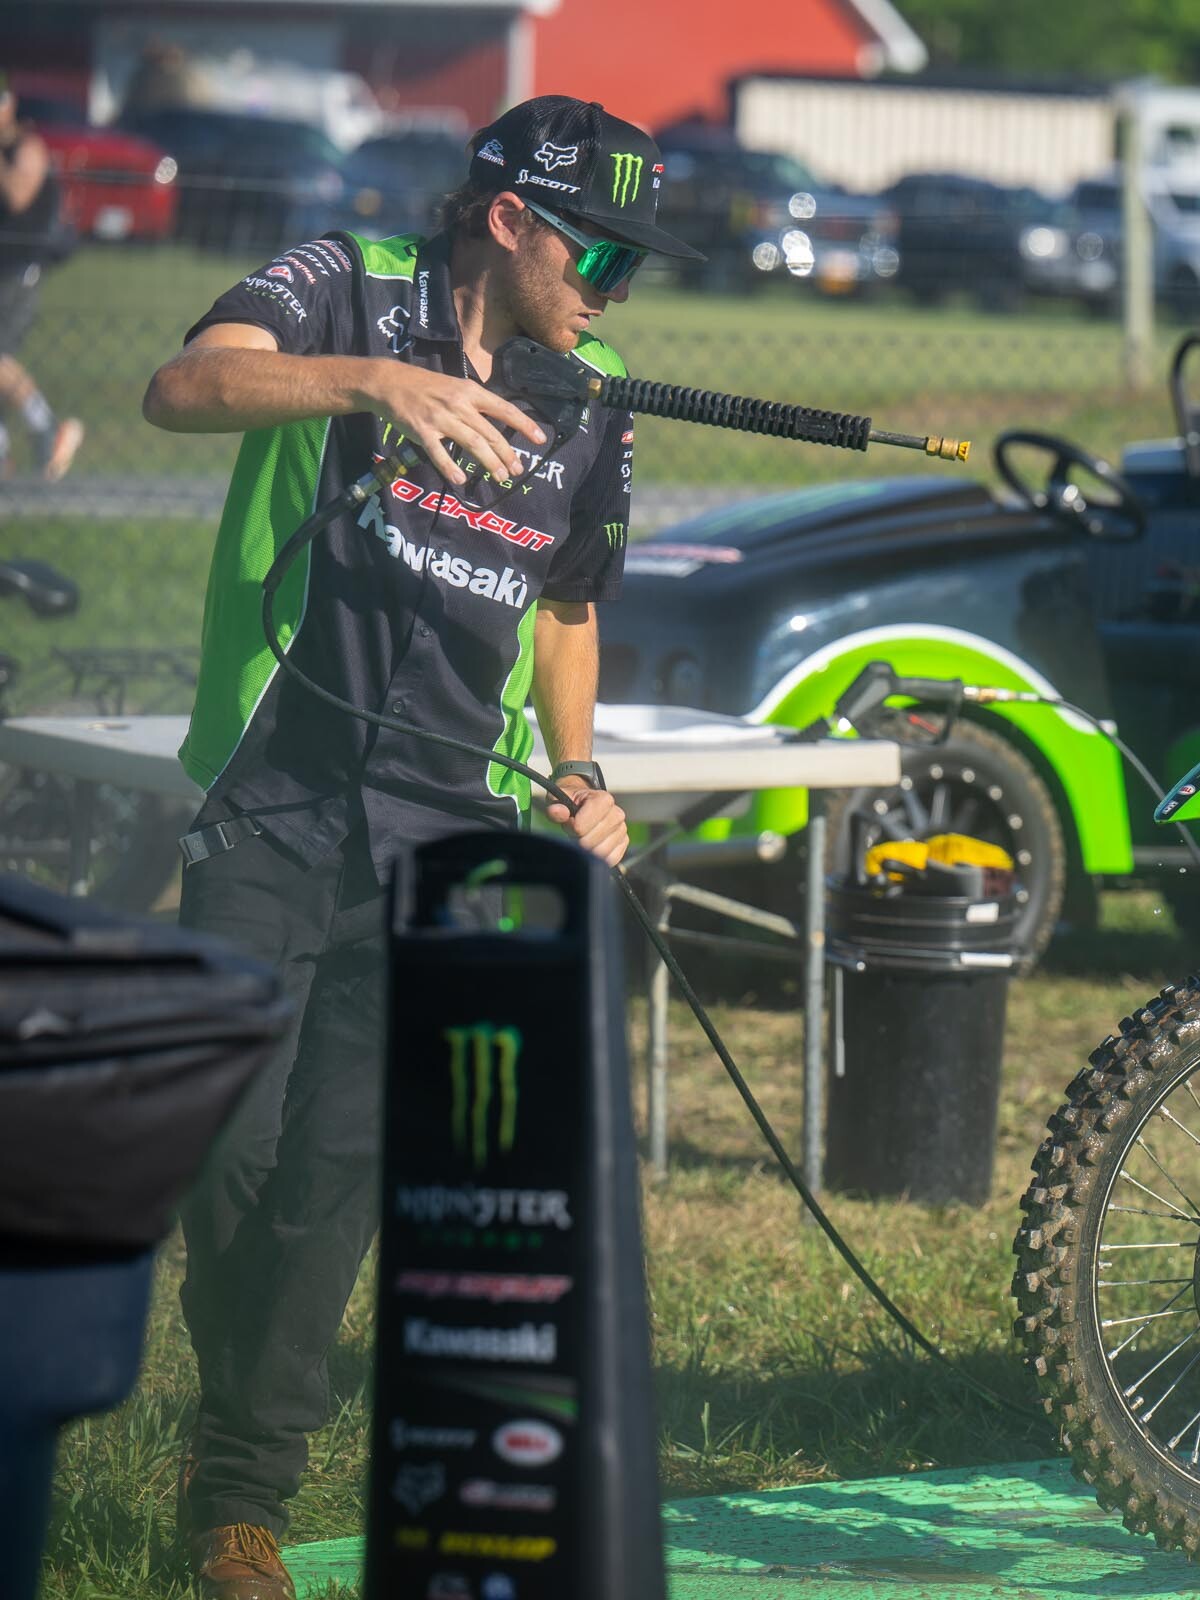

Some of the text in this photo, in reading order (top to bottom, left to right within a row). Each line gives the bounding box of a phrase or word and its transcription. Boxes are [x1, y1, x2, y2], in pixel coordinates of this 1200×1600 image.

[526, 175, 581, 194] SCOTT
[357, 494, 529, 610] Kawasaki
[419, 490, 556, 552] CIRCUIT
